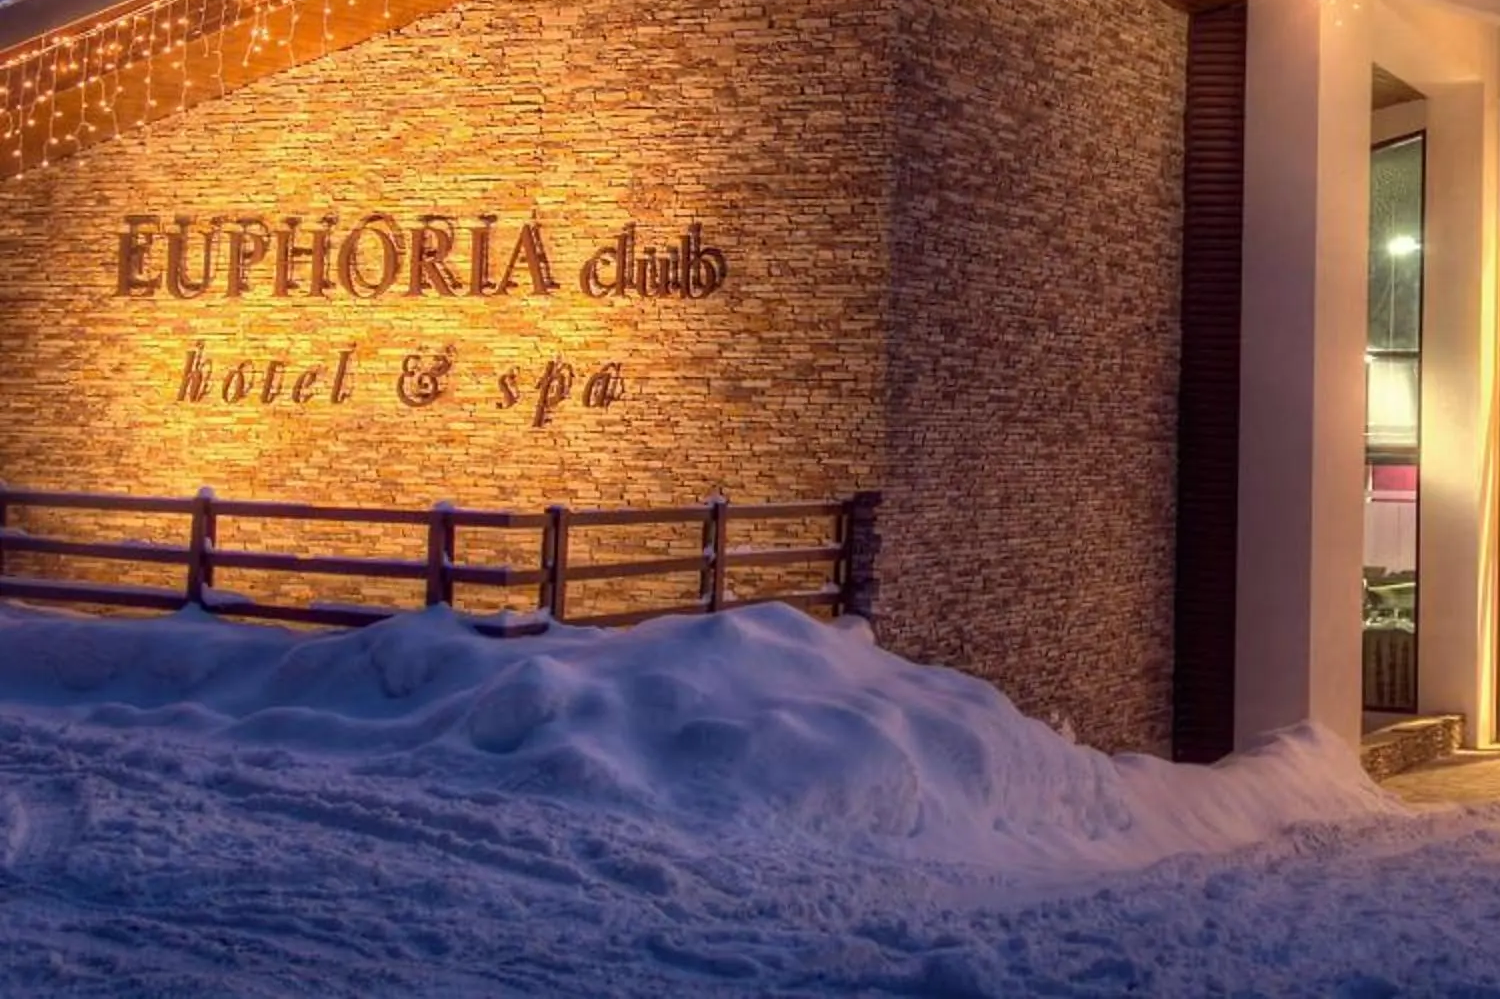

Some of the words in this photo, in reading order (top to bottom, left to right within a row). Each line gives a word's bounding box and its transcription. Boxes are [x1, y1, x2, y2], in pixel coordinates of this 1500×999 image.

[114, 216, 557, 299] EUPHORIA
[579, 222, 725, 299] club
[176, 345, 354, 404] hotel
[398, 348, 453, 407] &
[496, 358, 622, 428] spa
